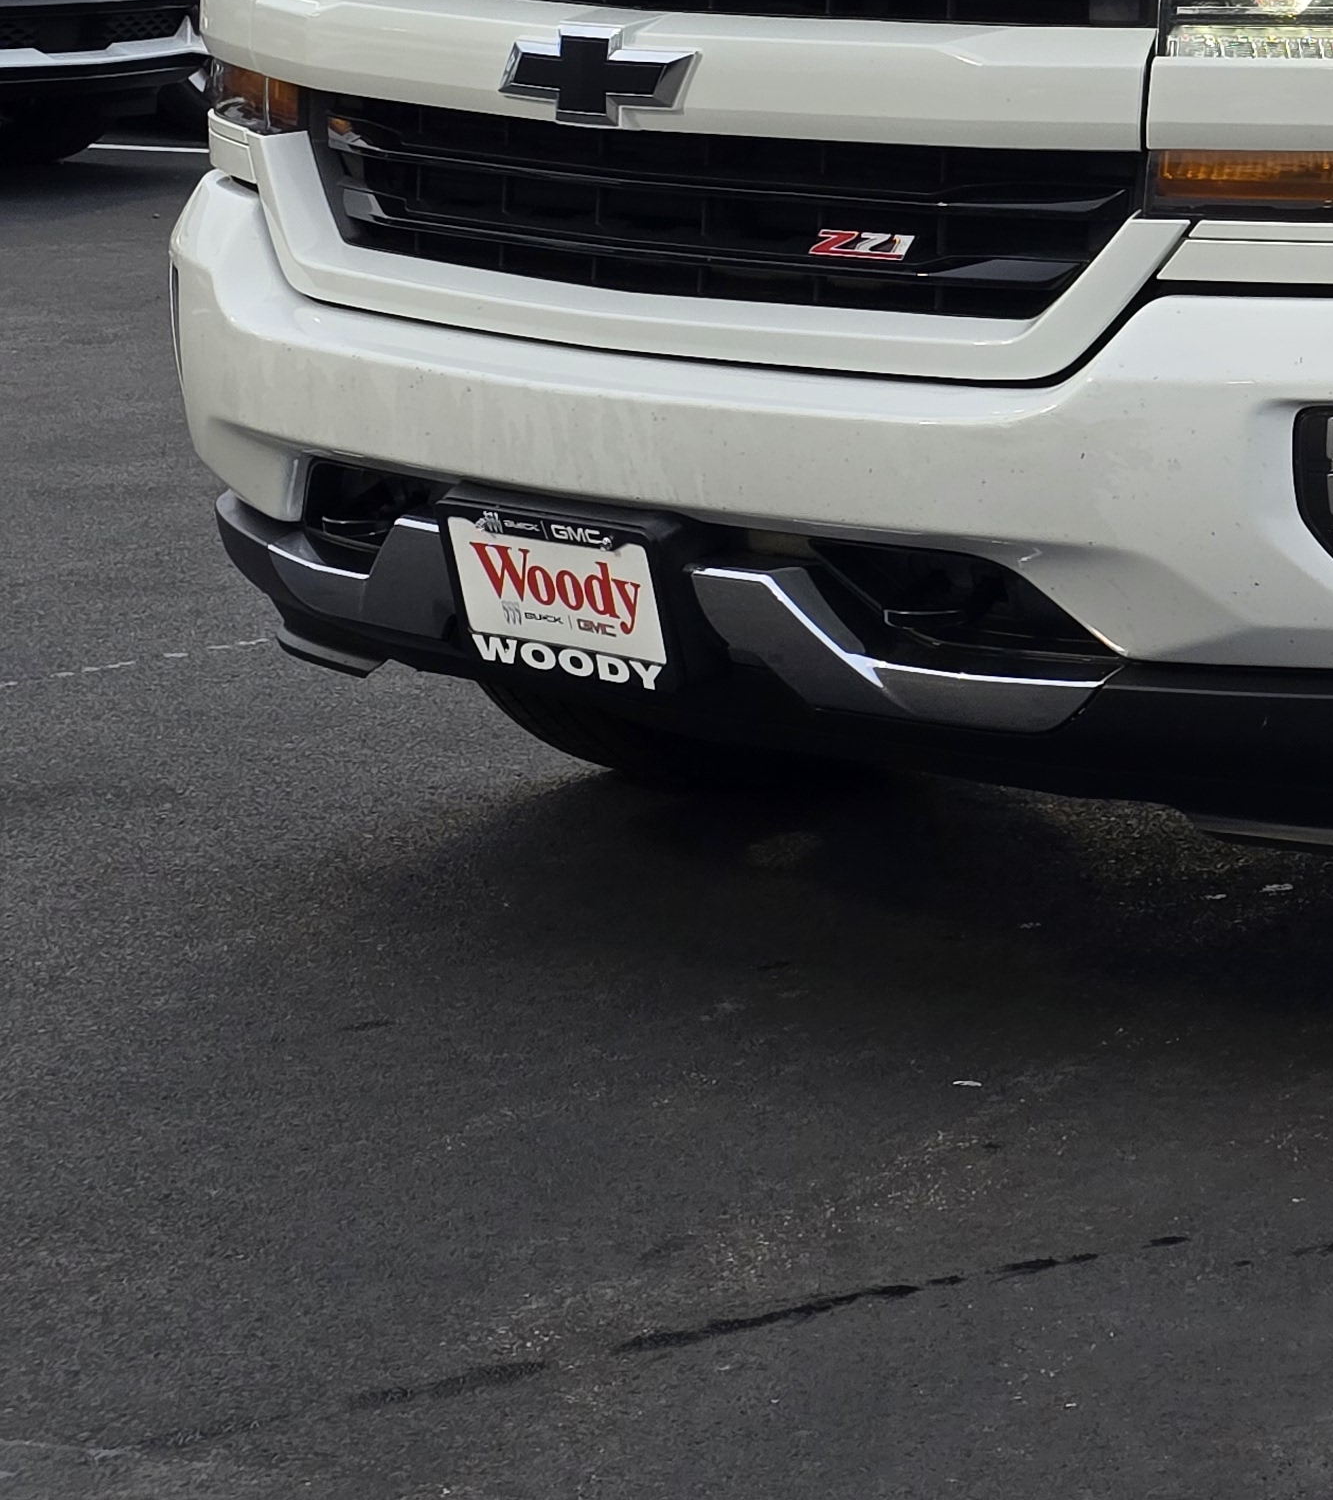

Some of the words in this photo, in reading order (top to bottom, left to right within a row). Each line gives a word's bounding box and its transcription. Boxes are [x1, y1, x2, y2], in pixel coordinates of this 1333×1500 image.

[808, 228, 916, 261] Z71
[503, 519, 541, 532] BUICK
[550, 523, 602, 544] GMC
[469, 541, 641, 635] Woody
[524, 611, 565, 625] BUICK
[576, 617, 618, 638] GMC
[471, 633, 663, 690] WOODY
